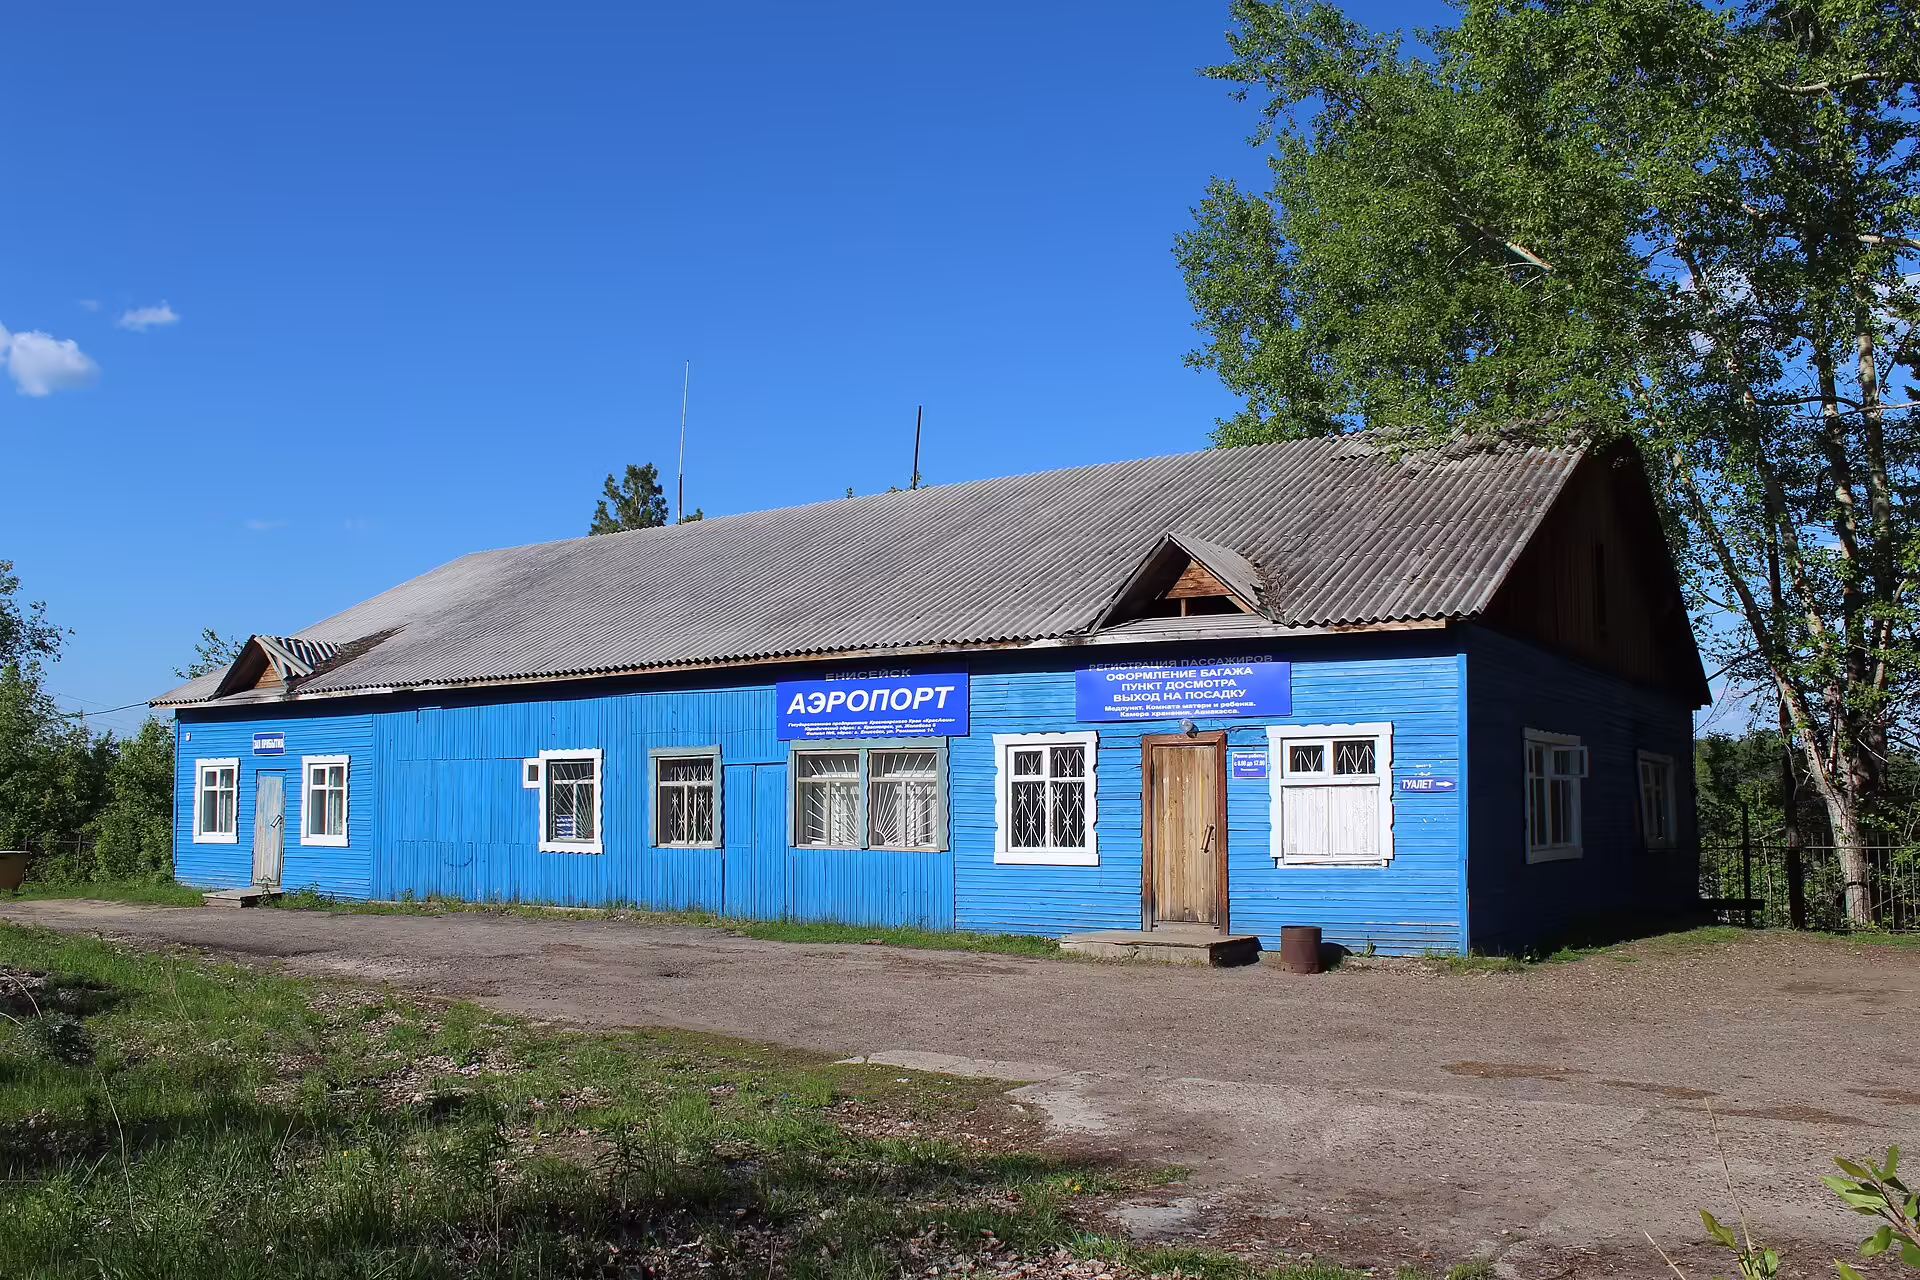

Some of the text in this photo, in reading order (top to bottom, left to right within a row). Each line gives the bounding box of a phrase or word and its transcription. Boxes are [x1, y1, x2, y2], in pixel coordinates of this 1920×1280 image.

[1089, 655, 1273, 672] РЕГИСТРАЦИЯ ПАССАЖИРОВ
[825, 669, 911, 682] ЕНИСЕЙСК
[1106, 666, 1253, 682] ОФОРМЛЕНИЕ БАГАЖА
[1121, 679, 1237, 692] ПУНКТ ДОСМОТРА
[786, 686, 955, 715] АЭРОПОРТ
[1113, 689, 1246, 703] ВЫХОД НА ПОСАДКУ
[1402, 779, 1434, 790] ТУАЛЕТ
